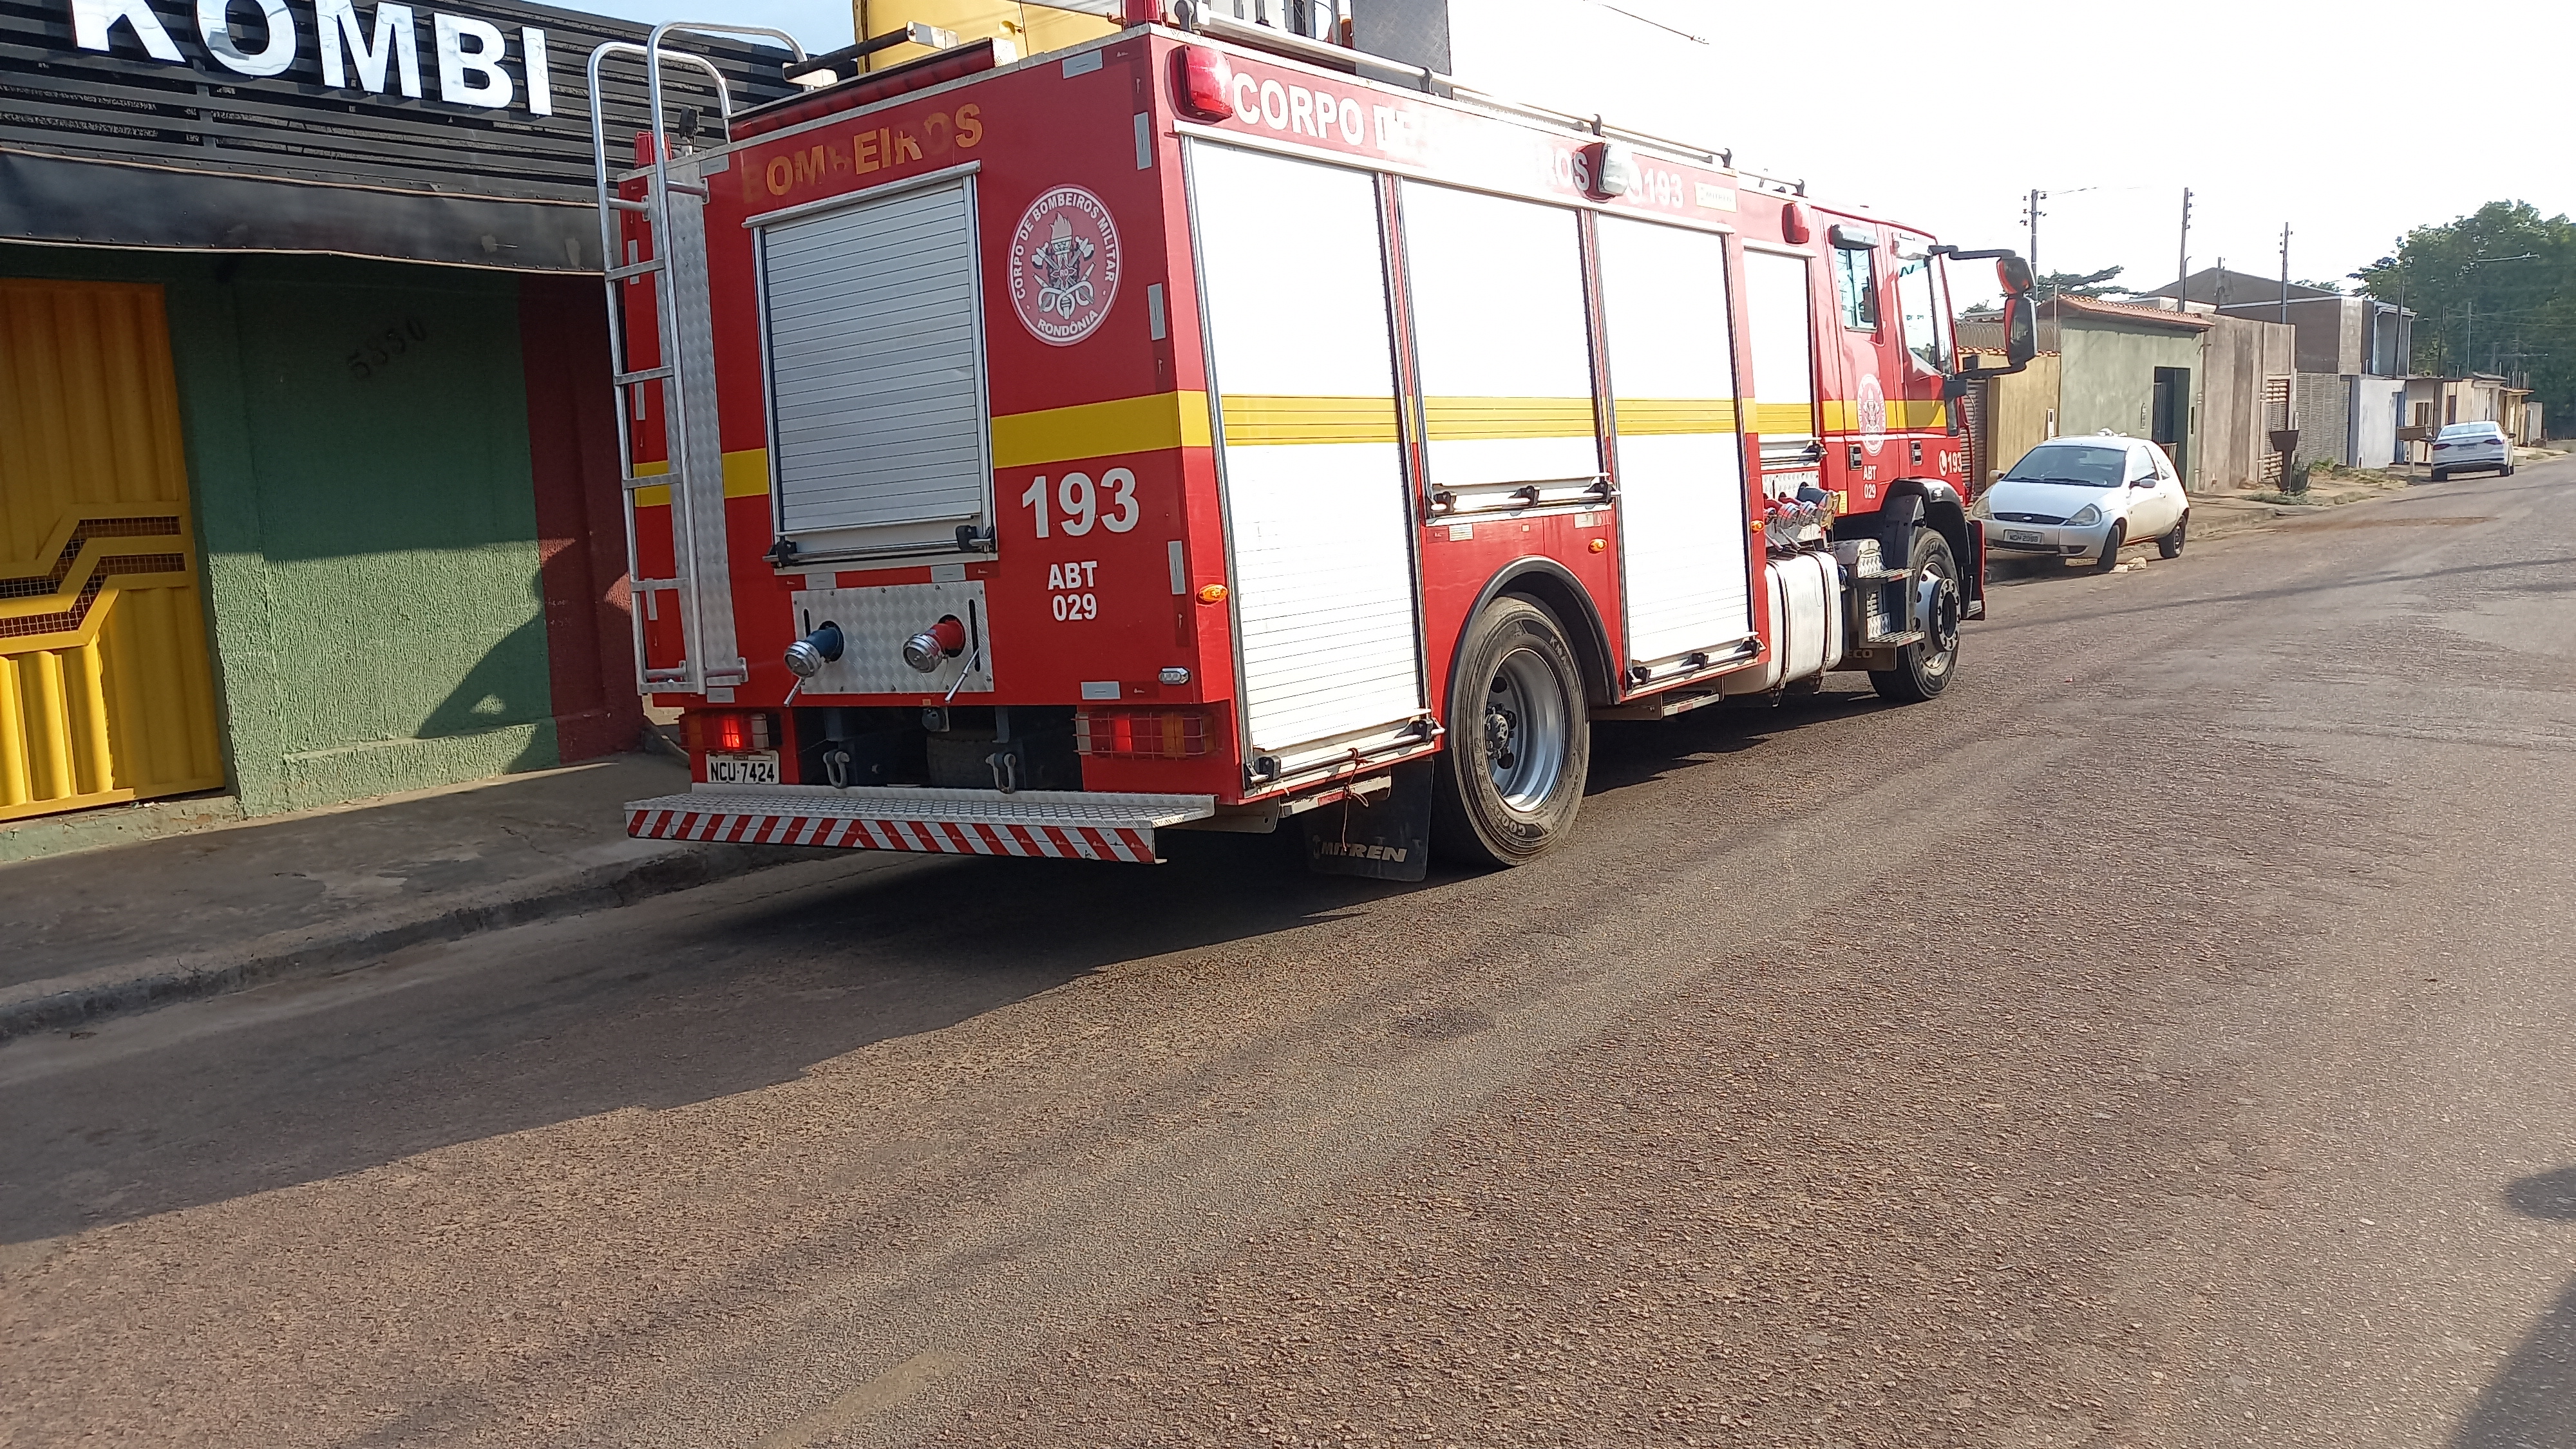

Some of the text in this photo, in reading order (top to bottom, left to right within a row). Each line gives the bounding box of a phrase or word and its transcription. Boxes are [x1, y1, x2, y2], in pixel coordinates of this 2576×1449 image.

[1233, 72, 1365, 146] CORPO
[1643, 167, 1684, 209] 193
[1013, 193, 1117, 299] CORPO DE BOMBEIROS MILITAR
[1037, 310, 1099, 337] RONDÔNIA
[1862, 465, 1877, 480] ABT
[1947, 451, 1963, 473] 193
[1022, 467, 1140, 538] 193
[1863, 483, 1877, 499] 029
[1048, 560, 1098, 591] ABT
[1052, 593, 1097, 621] 029
